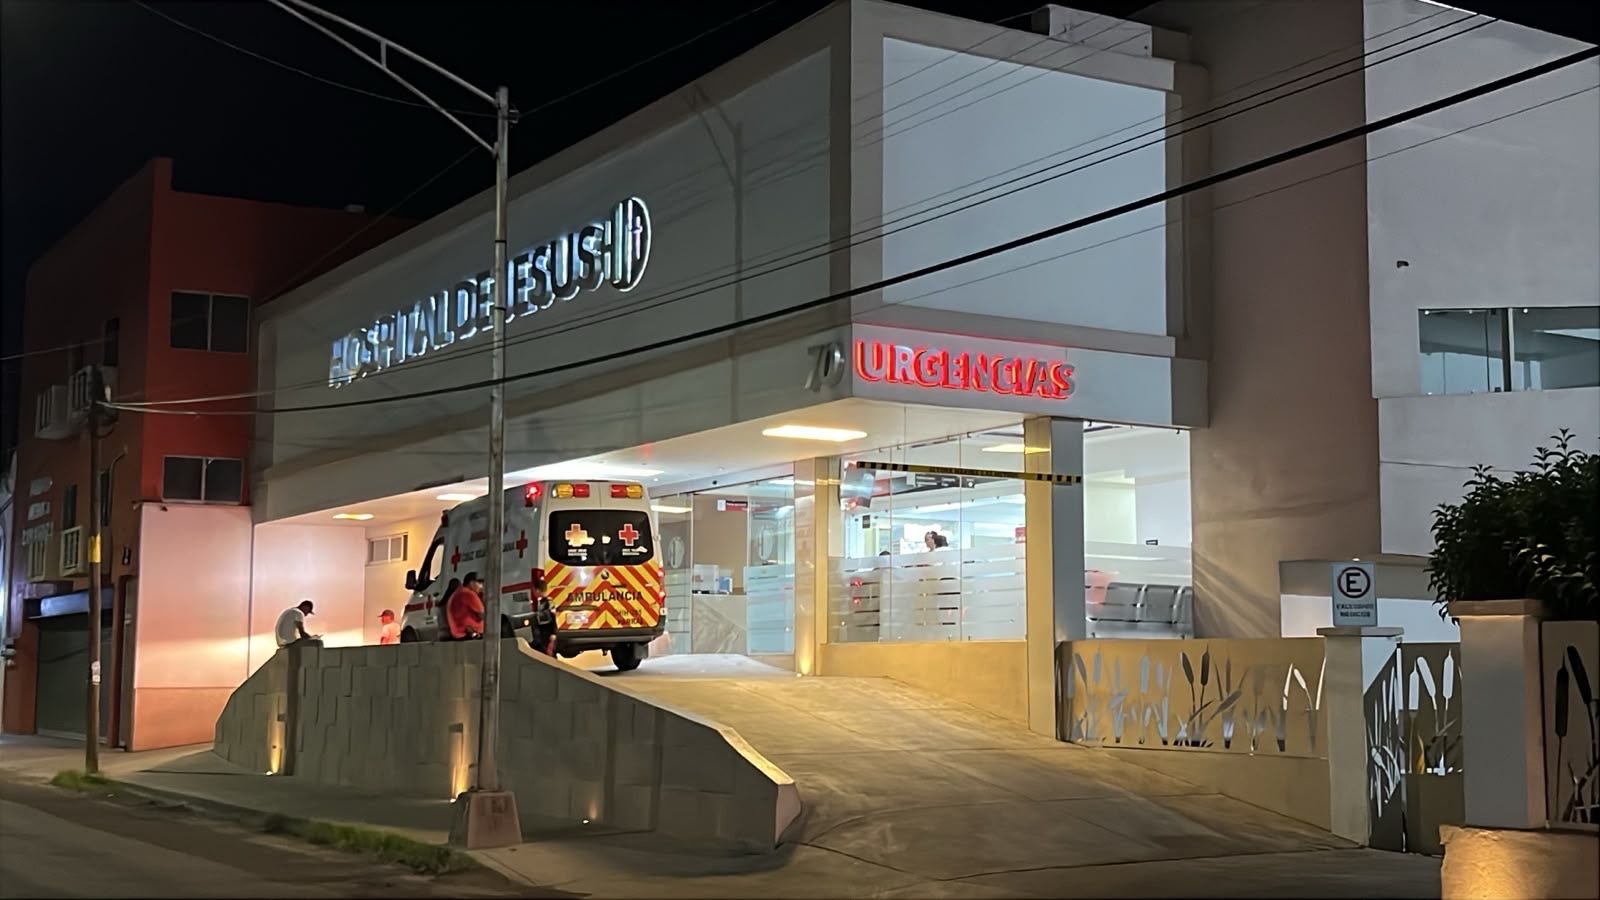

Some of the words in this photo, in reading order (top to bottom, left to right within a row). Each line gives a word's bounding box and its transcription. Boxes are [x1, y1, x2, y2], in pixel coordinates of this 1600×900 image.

[455, 268, 496, 340] DE
[804, 342, 846, 392] 70
[854, 337, 1076, 400] URGENCIAS
[567, 591, 643, 602] AMBULANCIA
[1346, 572, 1362, 592] E
